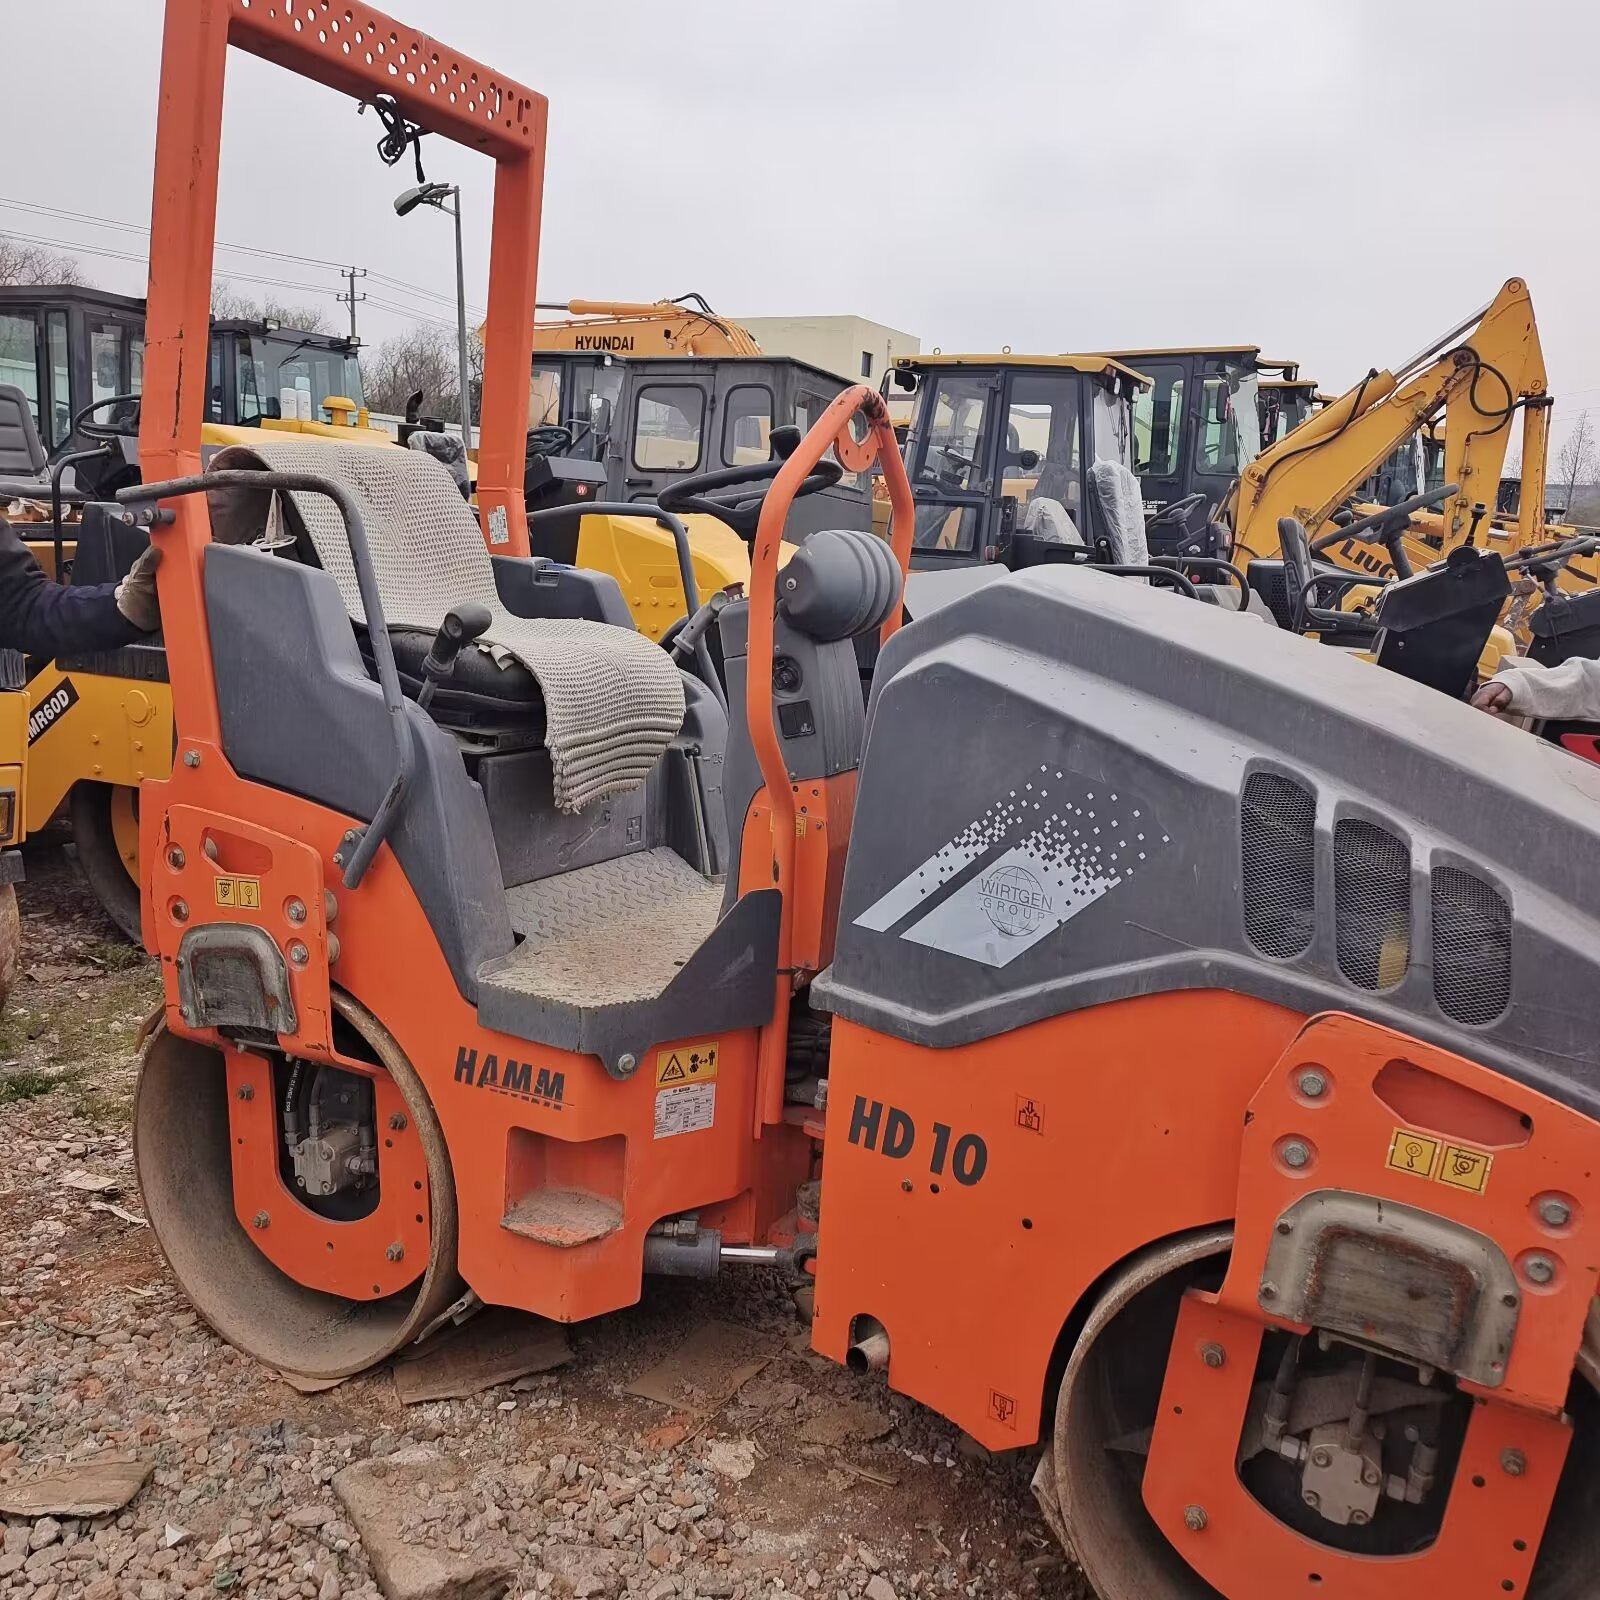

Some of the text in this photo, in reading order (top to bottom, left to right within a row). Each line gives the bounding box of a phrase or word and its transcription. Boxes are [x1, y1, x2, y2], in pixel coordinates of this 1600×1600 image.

[575, 336, 634, 351] HYUNDAI
[980, 878, 1053, 911] WIRTGEN
[983, 897, 1045, 922] GROUP
[454, 1045, 565, 1108] HAMM
[848, 1094, 988, 1187] HD 10
